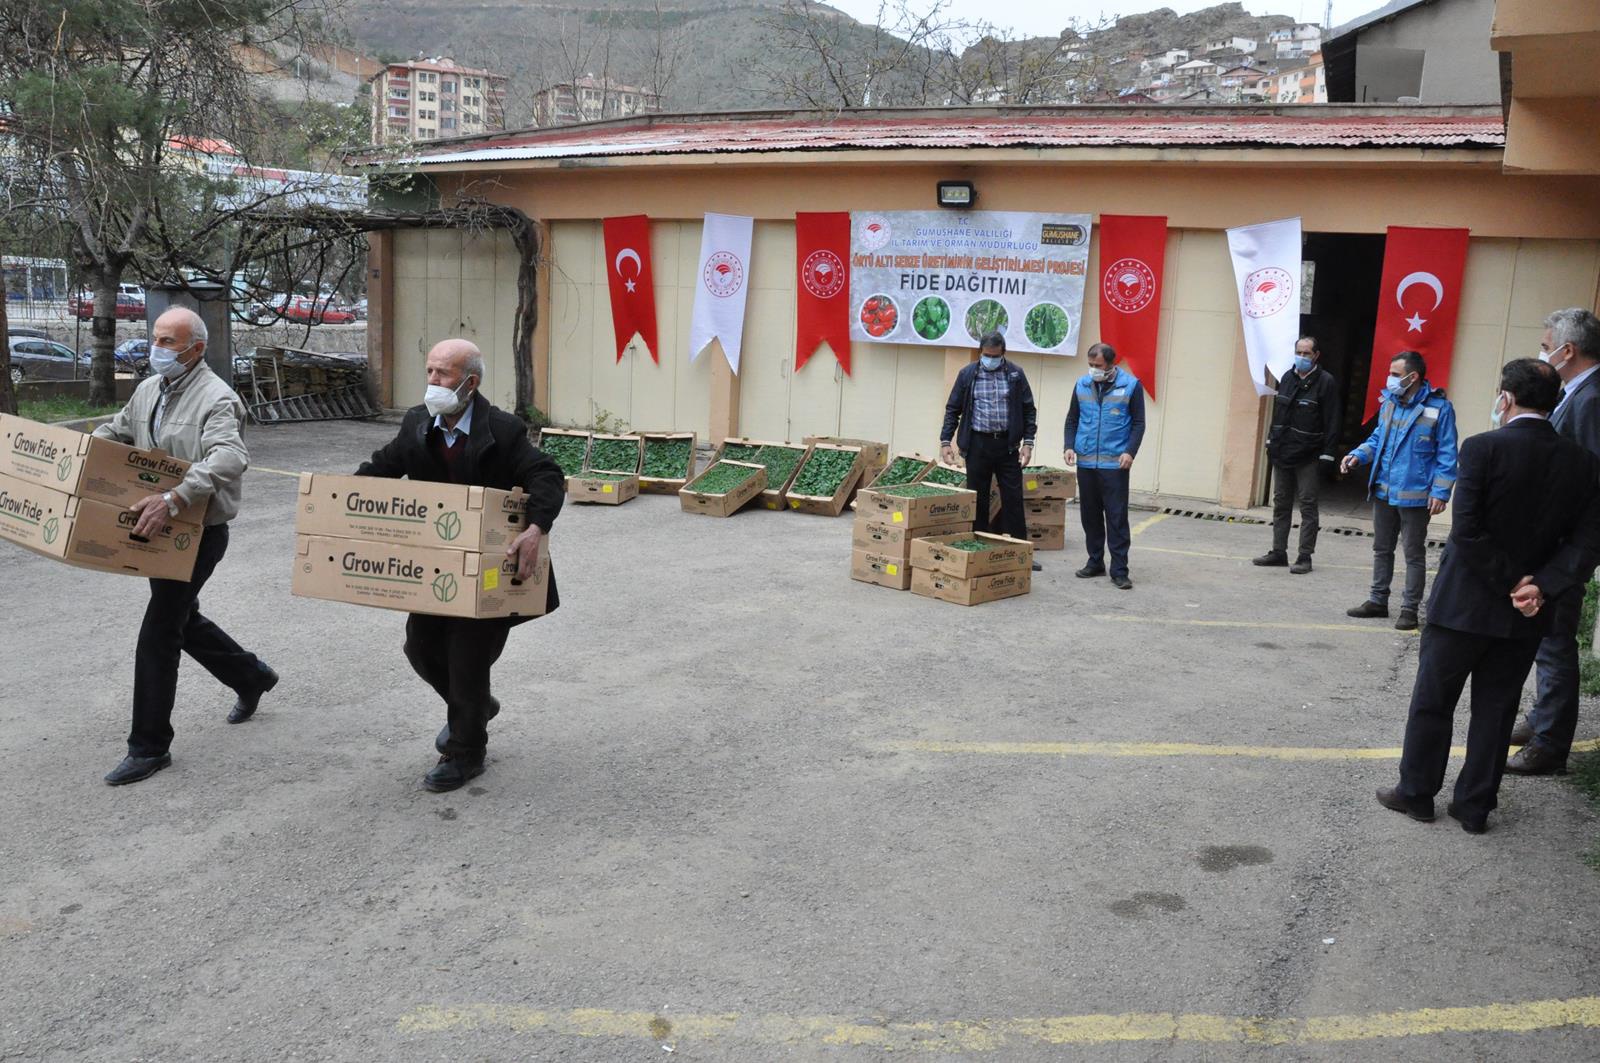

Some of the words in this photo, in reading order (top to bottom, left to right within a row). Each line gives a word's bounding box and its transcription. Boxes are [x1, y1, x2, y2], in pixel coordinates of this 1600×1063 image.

[901, 240, 929, 248] TARIM
[931, 240, 942, 248] VE
[944, 240, 977, 249] ORMAN
[875, 255, 893, 268] ALTI
[900, 270, 940, 290] FİDE
[945, 271, 1027, 295] DAĞITIMI
[14, 432, 38, 455] Grow
[37, 439, 58, 460] Fide
[128, 451, 158, 469] Grow
[159, 460, 183, 476] Fide
[21, 499, 43, 521] Fide
[347, 492, 388, 514] Grow
[391, 497, 428, 519] Fide
[929, 503, 945, 514] Grow
[945, 502, 960, 511] Fide
[343, 552, 385, 574] Grow
[388, 557, 424, 579] Fide
